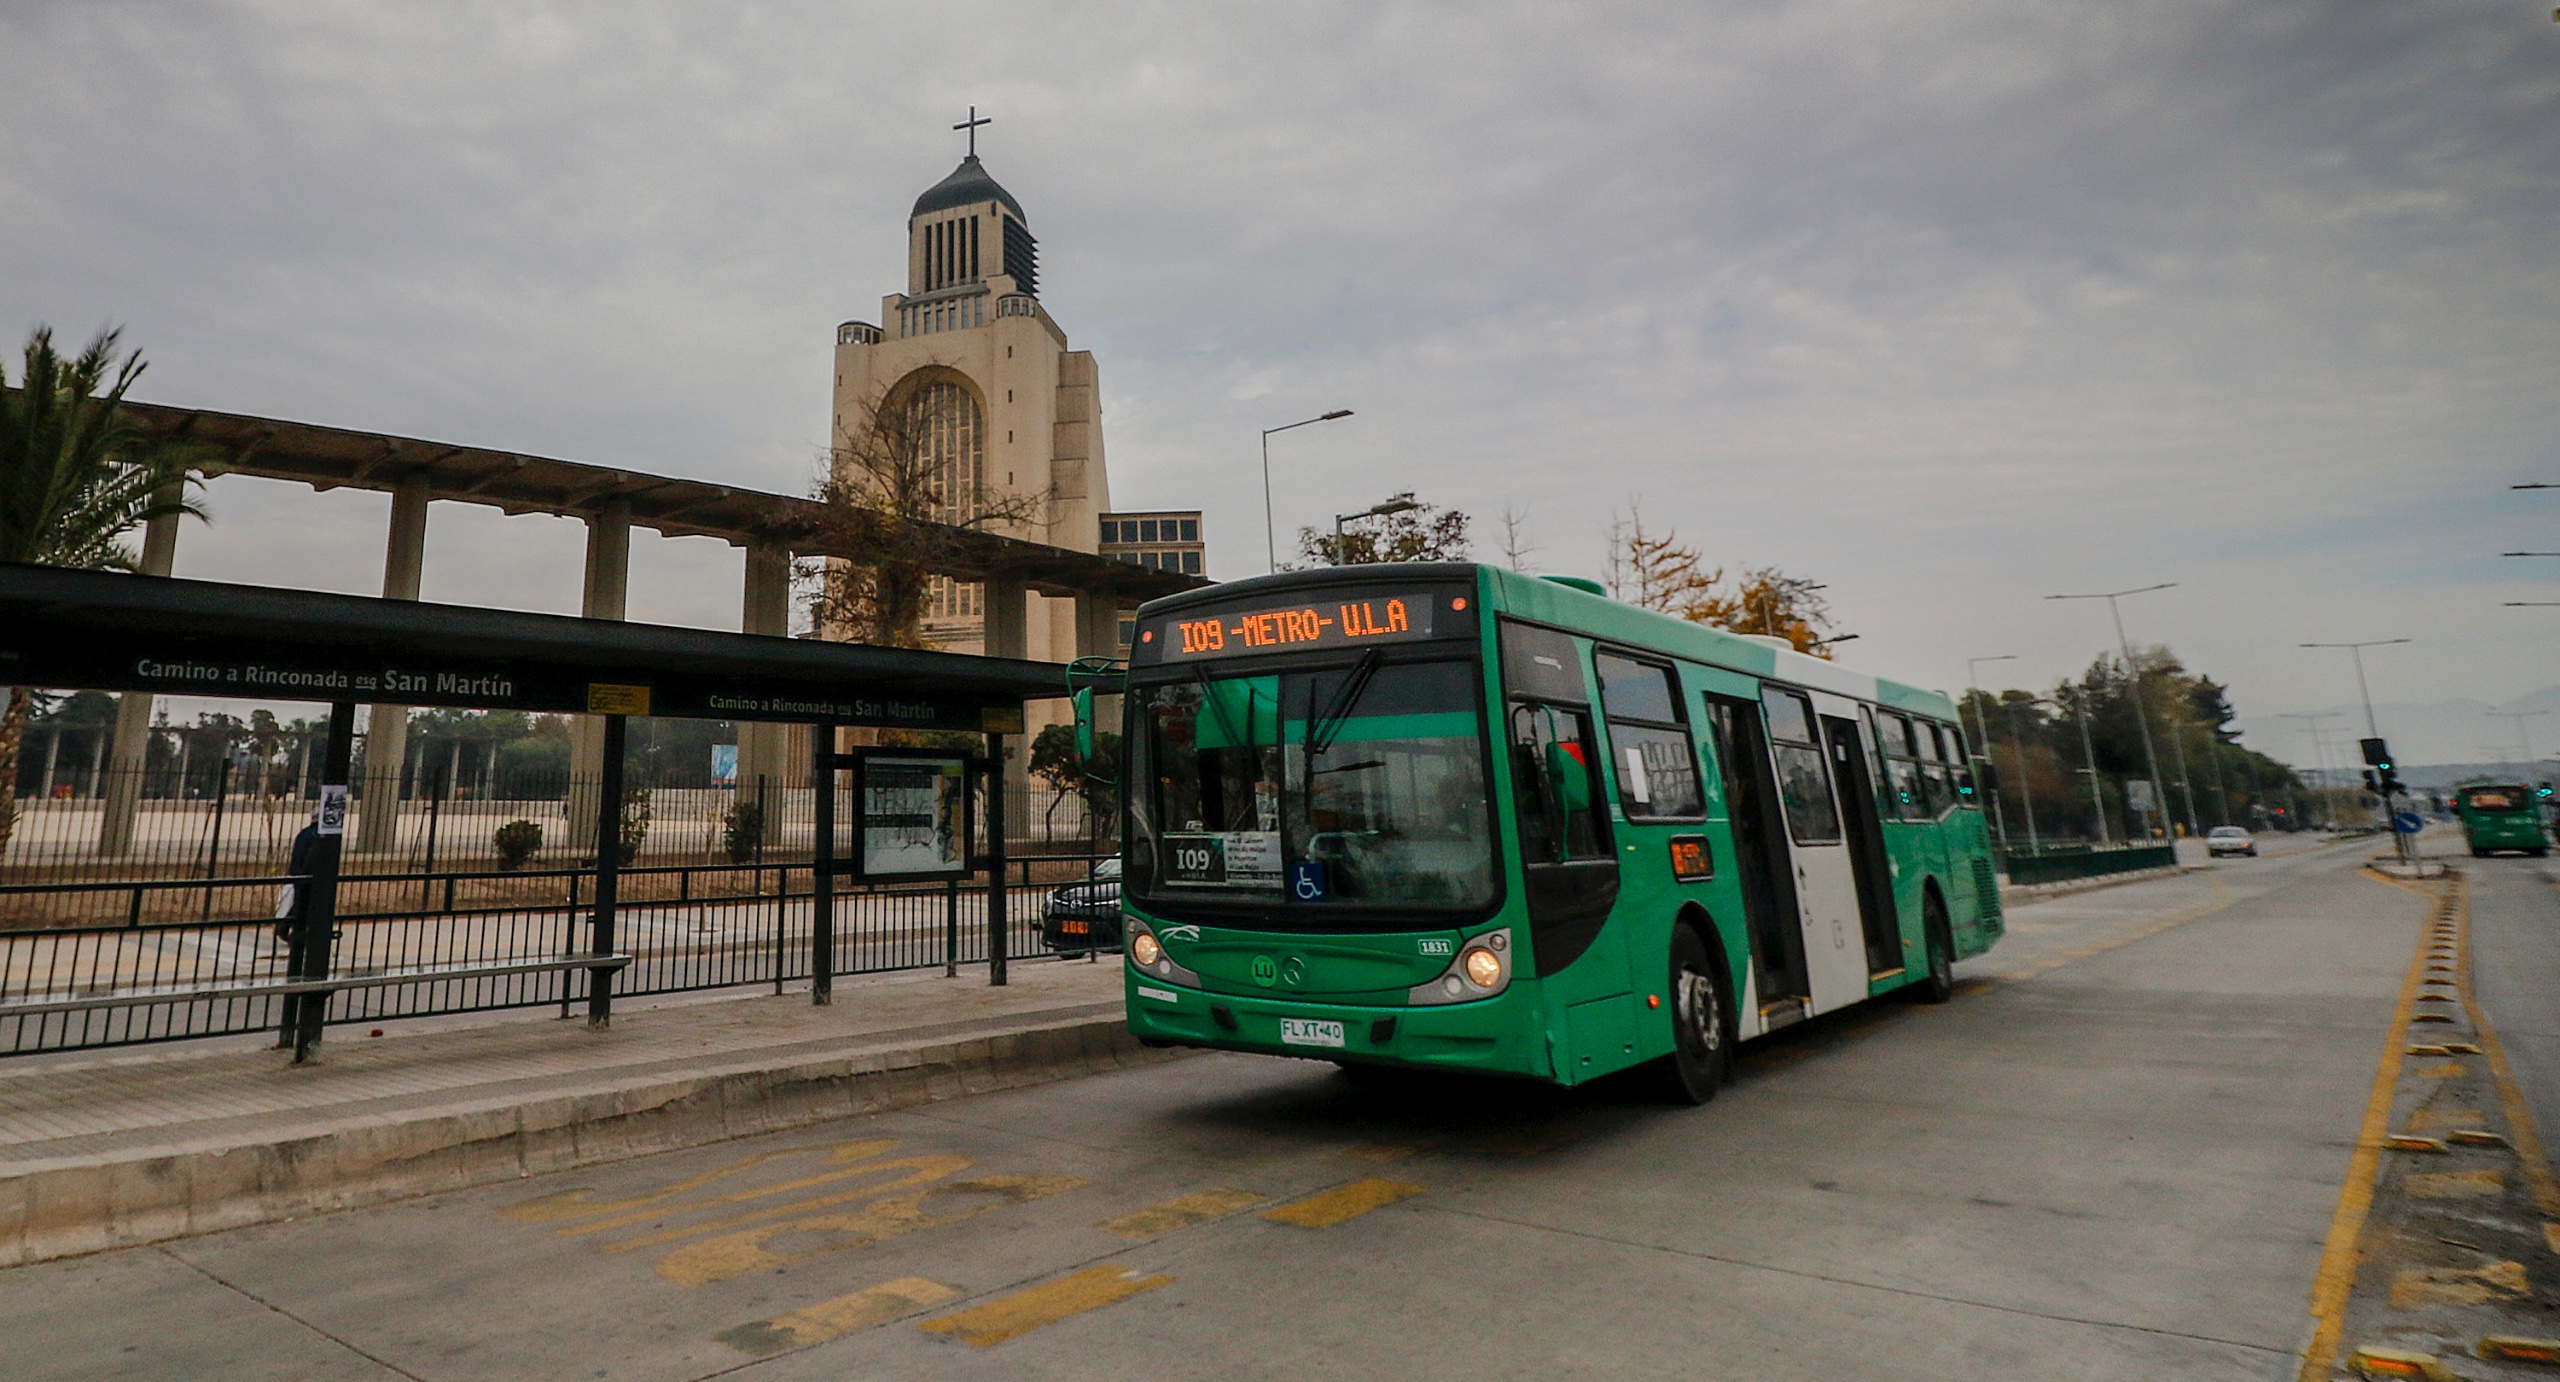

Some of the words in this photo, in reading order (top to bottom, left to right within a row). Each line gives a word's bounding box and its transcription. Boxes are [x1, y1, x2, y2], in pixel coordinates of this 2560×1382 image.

[1179, 620, 1224, 653] I09
[137, 659, 218, 681] Camino
[226, 667, 237, 682] a
[245, 666, 348, 689] Rinconada
[384, 670, 427, 692] San
[436, 673, 512, 697] Martín
[709, 695, 758, 711] Camino
[761, 701, 769, 711] a
[772, 698, 834, 715] Rinconada
[856, 700, 883, 717] San
[887, 701, 935, 719] Martín
[1176, 849, 1210, 870] I09
[1422, 942, 1449, 953] 1831
[1254, 963, 1273, 979] LU
